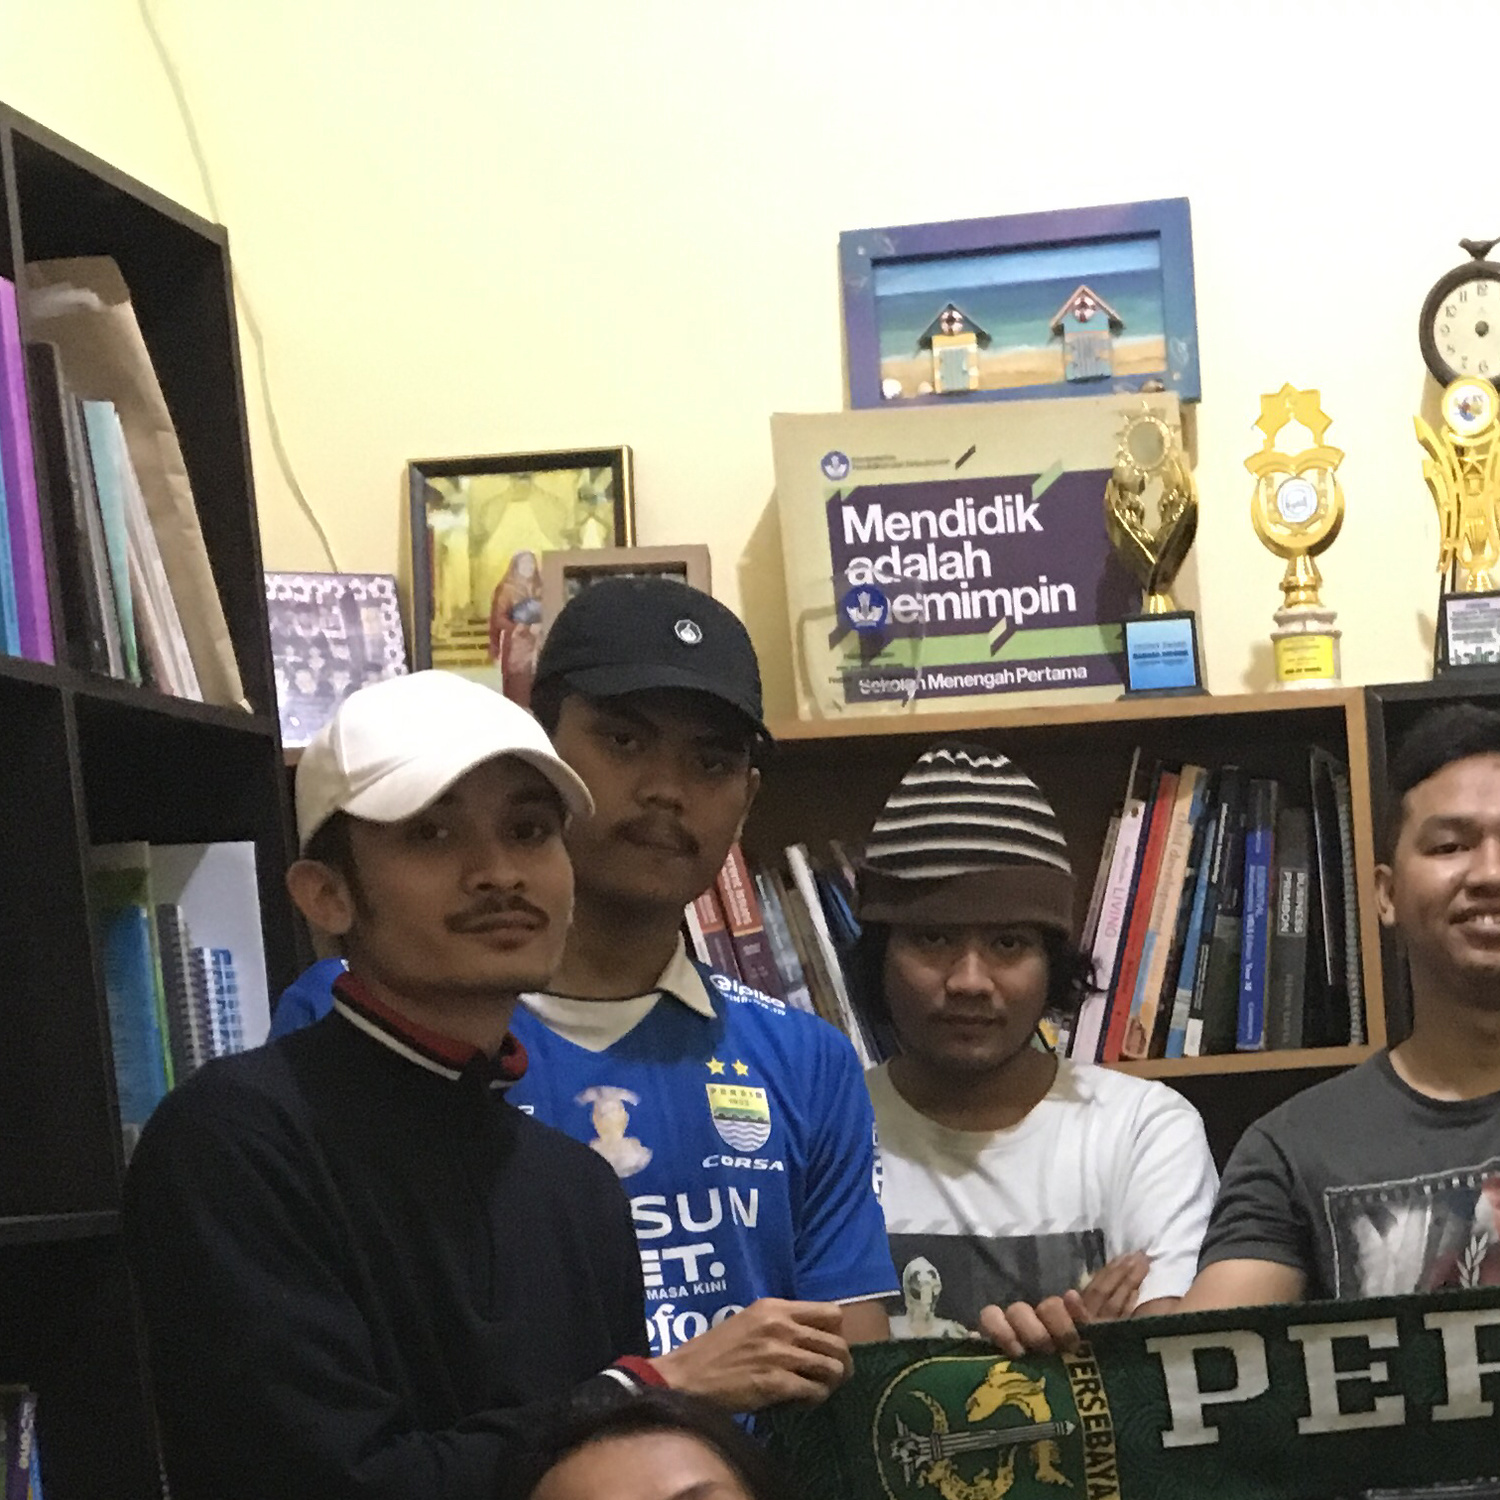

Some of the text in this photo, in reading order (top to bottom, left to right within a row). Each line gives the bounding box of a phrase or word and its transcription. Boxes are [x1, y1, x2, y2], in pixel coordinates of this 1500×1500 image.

[841, 493, 1044, 545] Mendidik
[846, 540, 992, 586] adalah
[881, 575, 1077, 625] emimpin
[928, 667, 1015, 690] Menengah
[1016, 664, 1088, 684] Pertama
[1104, 887, 1128, 938] LIVING
[702, 1155, 785, 1172] CORSA
[630, 1187, 759, 1240] SUN
[640, 1243, 726, 1287] ET.
[646, 1279, 727, 1301] MASA KINI
